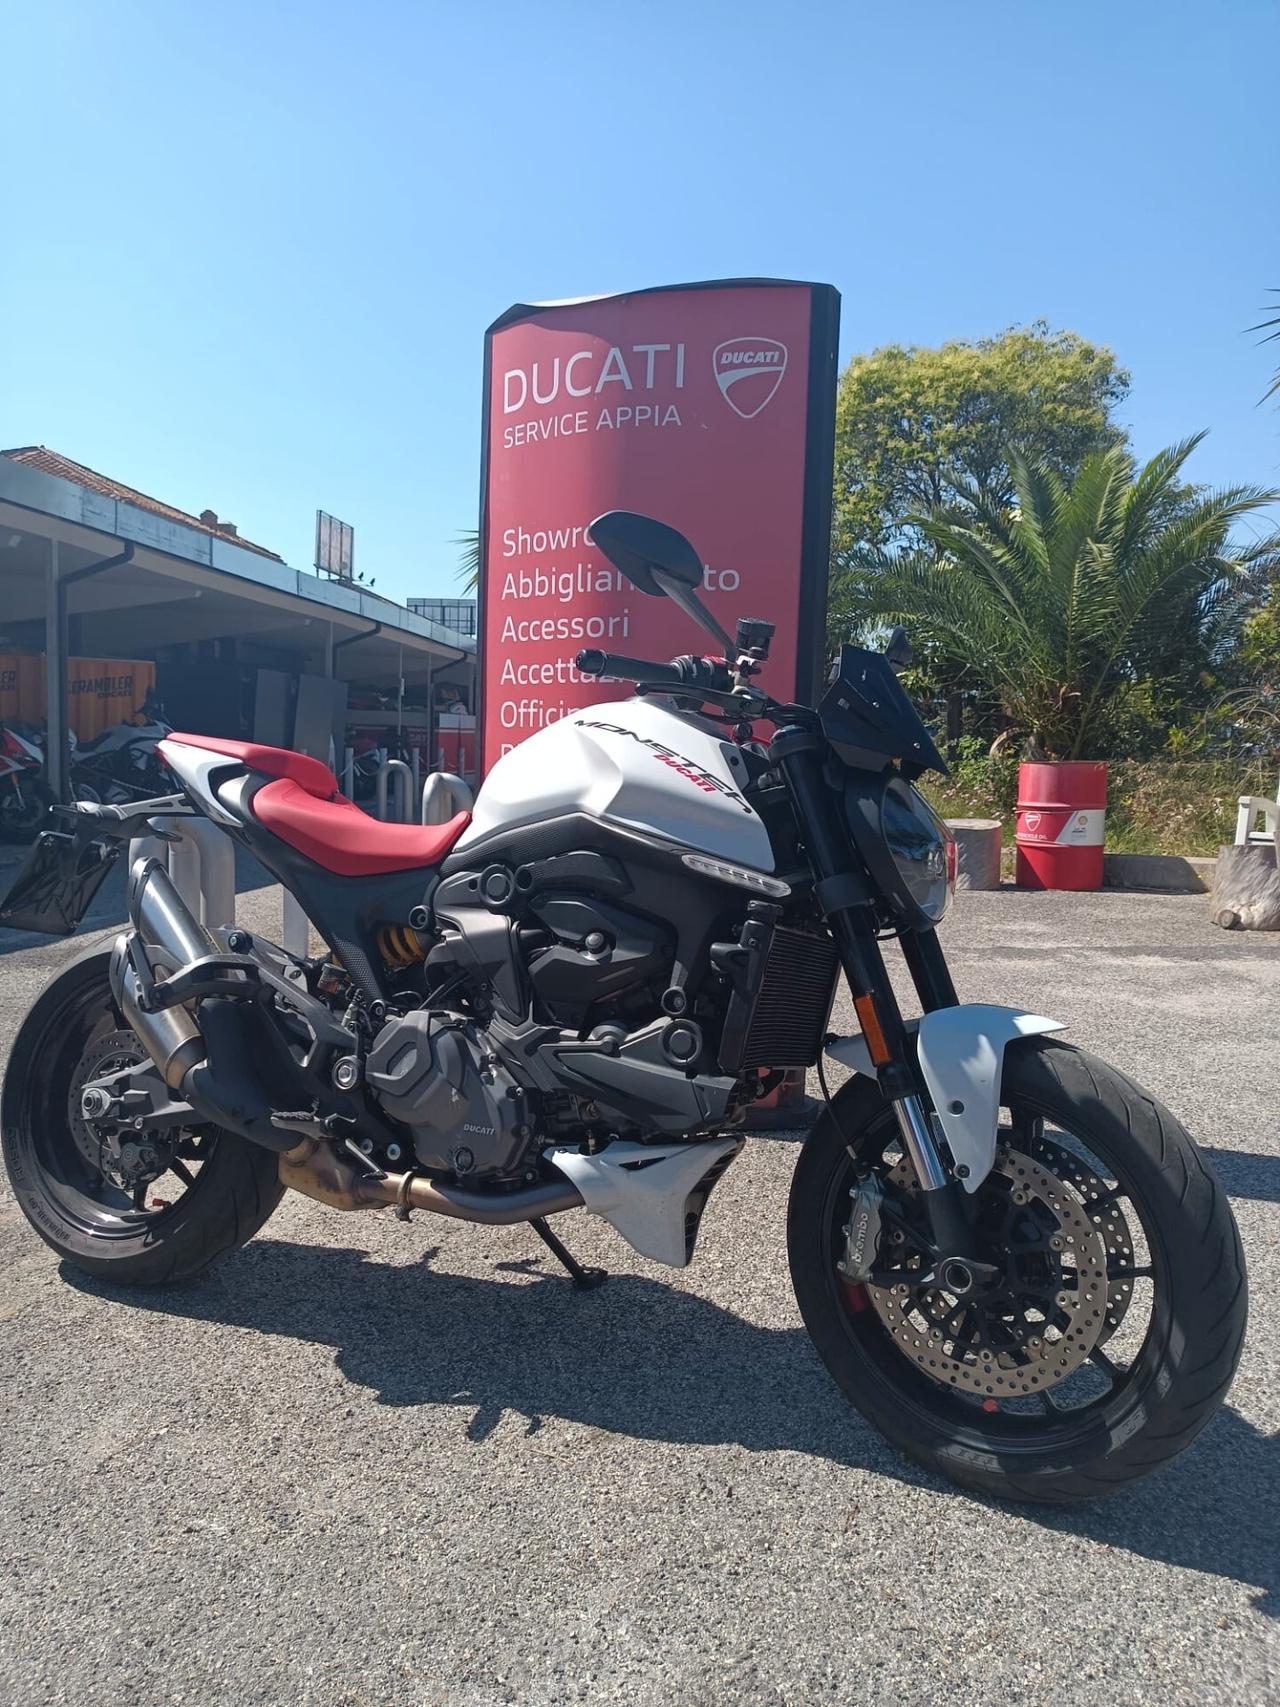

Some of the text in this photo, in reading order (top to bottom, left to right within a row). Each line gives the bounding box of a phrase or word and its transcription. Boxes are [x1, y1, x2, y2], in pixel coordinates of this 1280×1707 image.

[720, 350, 780, 365] DUCATI
[503, 343, 686, 415] DUCATI
[503, 404, 682, 449] SERVICE APPIA
[503, 526, 596, 557] Showro
[501, 563, 740, 603] Abbigliato
[500, 609, 629, 643] Accessori
[574, 720, 752, 814] MONSTER
[653, 753, 718, 793] DUCATI
[463, 1123, 495, 1136] DUCATI
[851, 1212, 869, 1264] brembo
